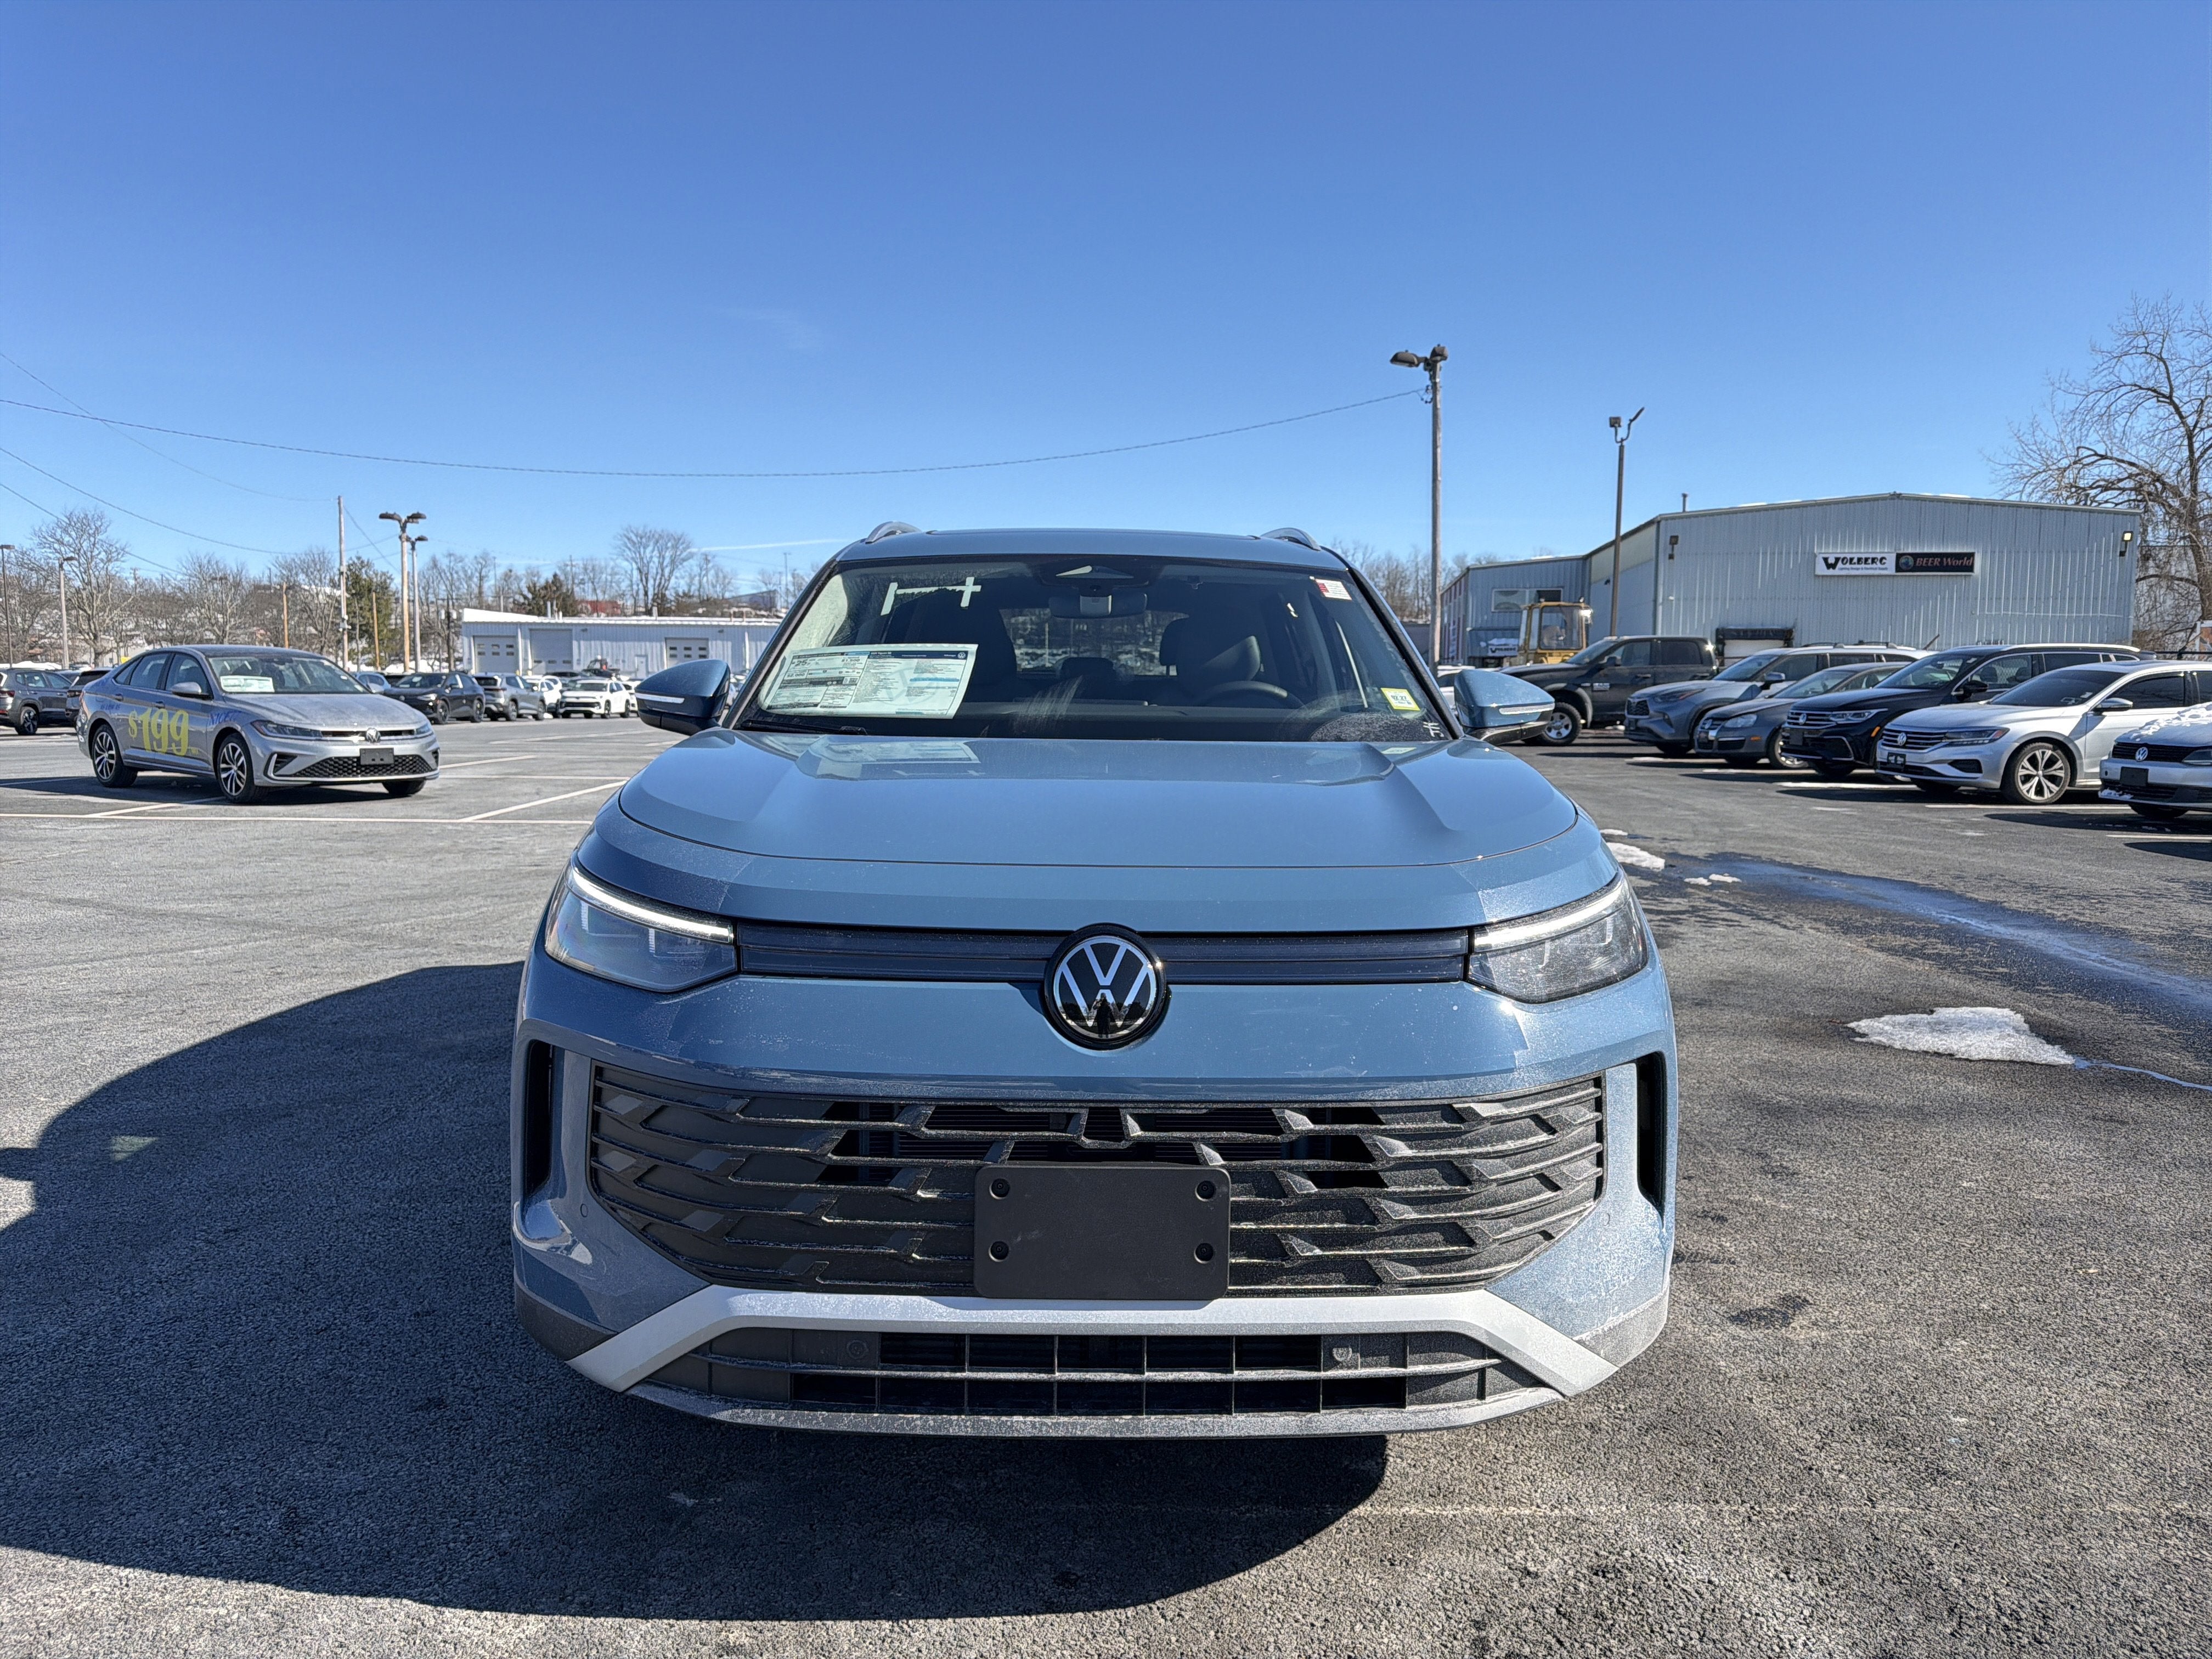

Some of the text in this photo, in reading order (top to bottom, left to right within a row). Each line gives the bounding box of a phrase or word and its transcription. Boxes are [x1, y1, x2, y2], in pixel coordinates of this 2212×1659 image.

[1822, 556, 1887, 570] WOLBERG
[1916, 556, 1973, 566] BEER World
[1054, 936, 1156, 1039] VW
